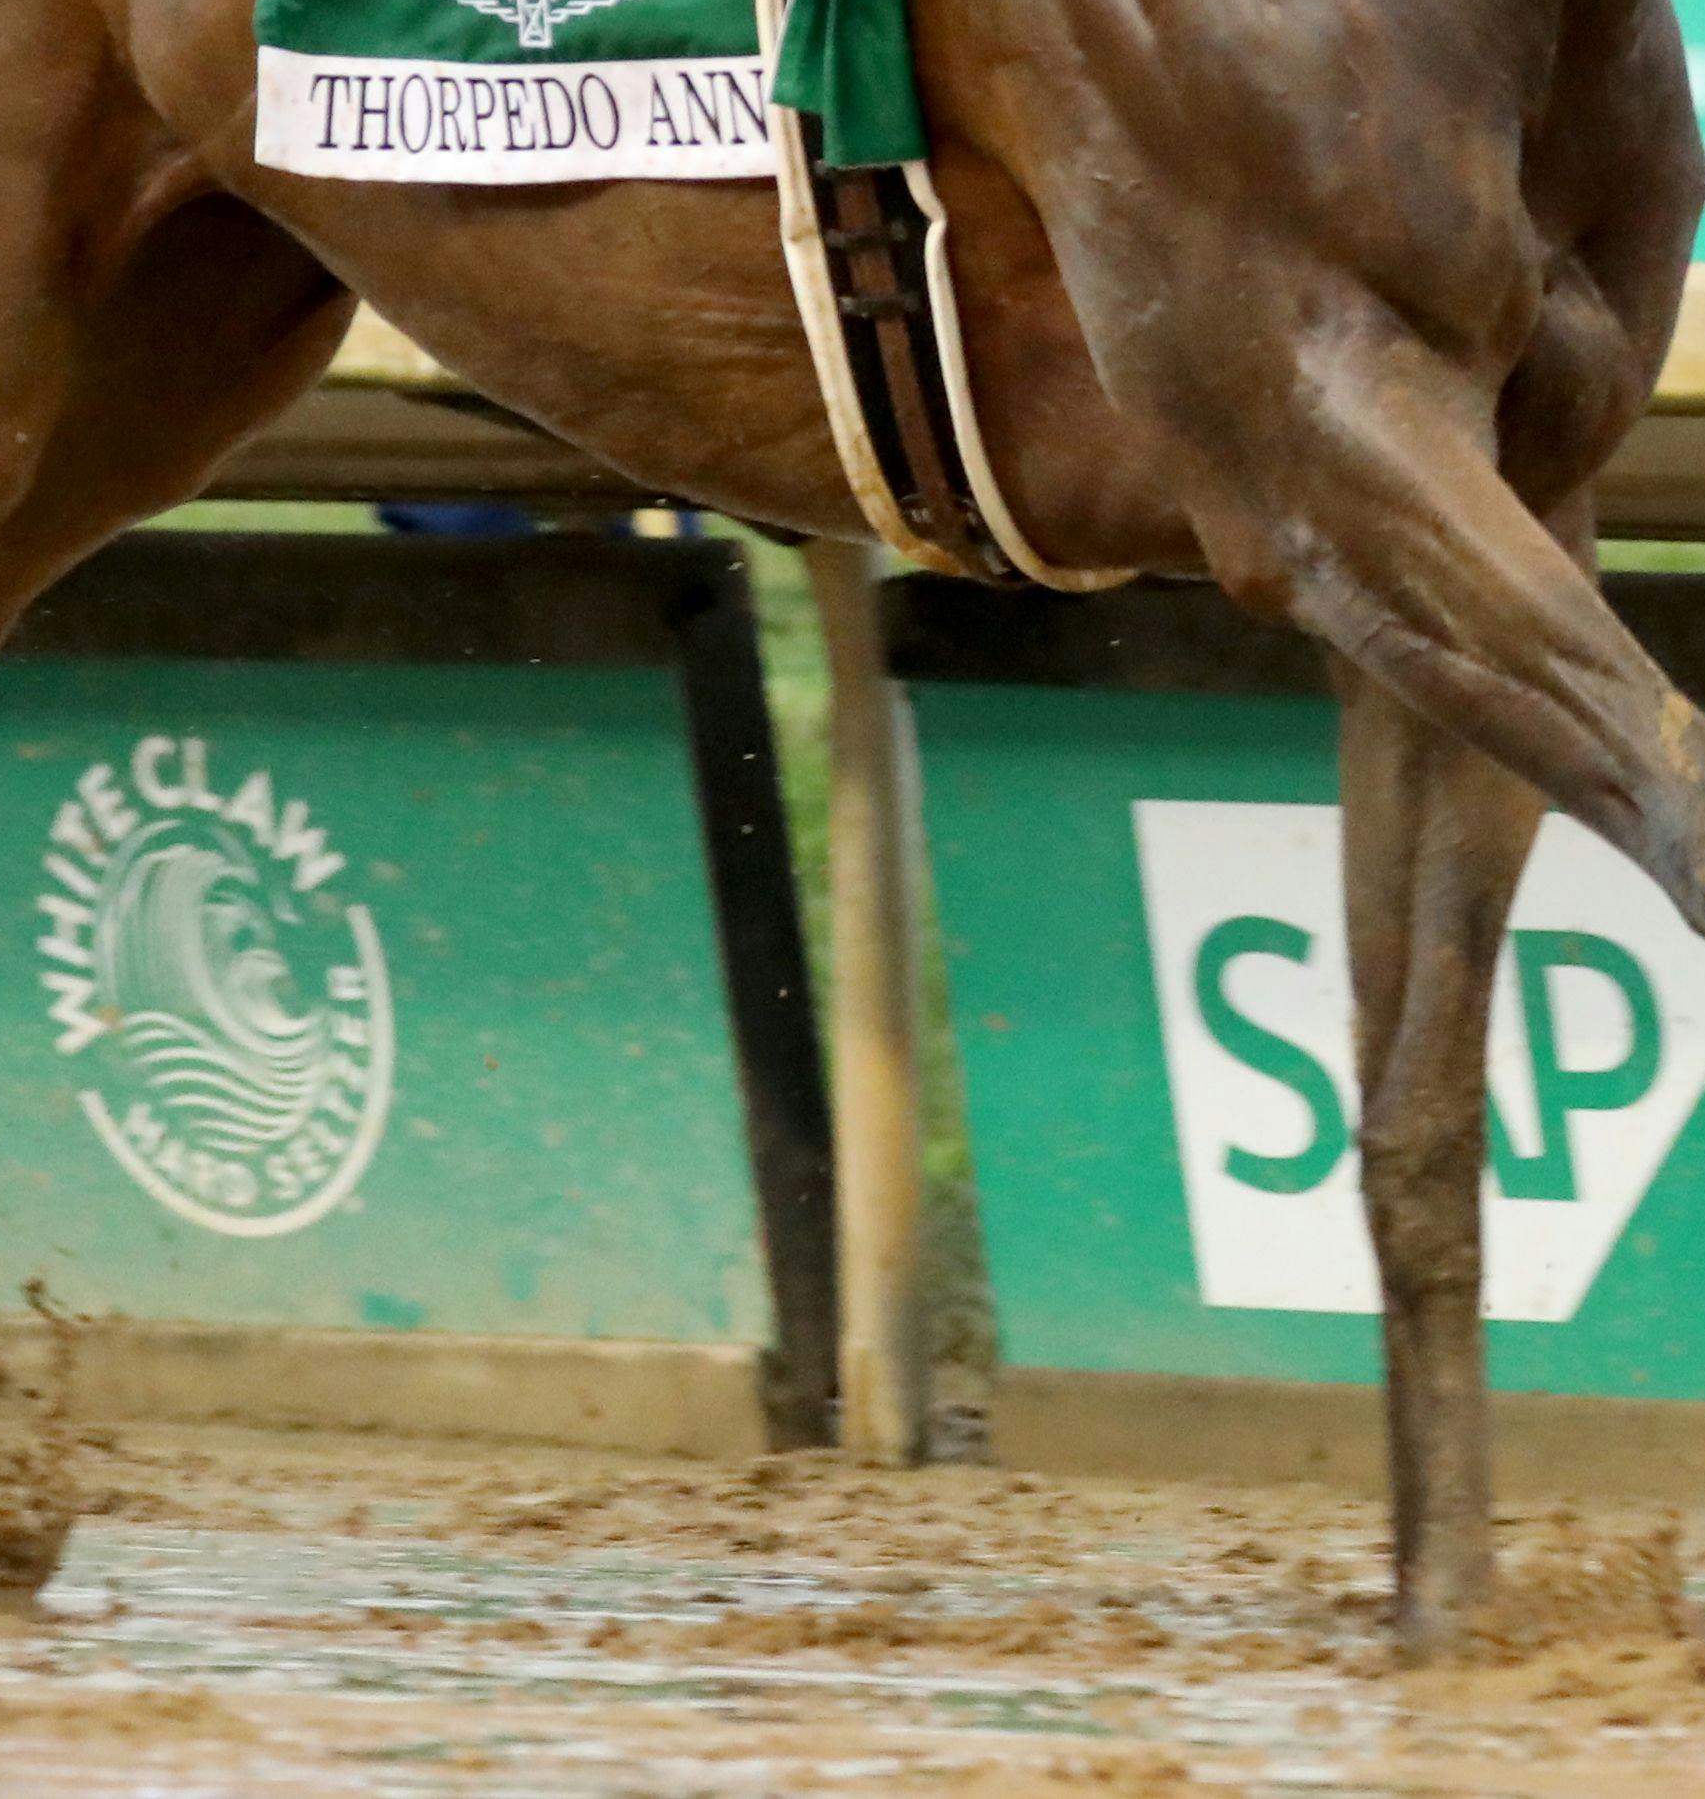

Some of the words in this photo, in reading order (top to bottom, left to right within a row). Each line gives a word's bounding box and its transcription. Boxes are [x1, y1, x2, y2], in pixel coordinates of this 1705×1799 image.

[310, 73, 621, 153] THORPEDO
[37, 762, 141, 1054] WHITE
[131, 735, 347, 892] CLAW
